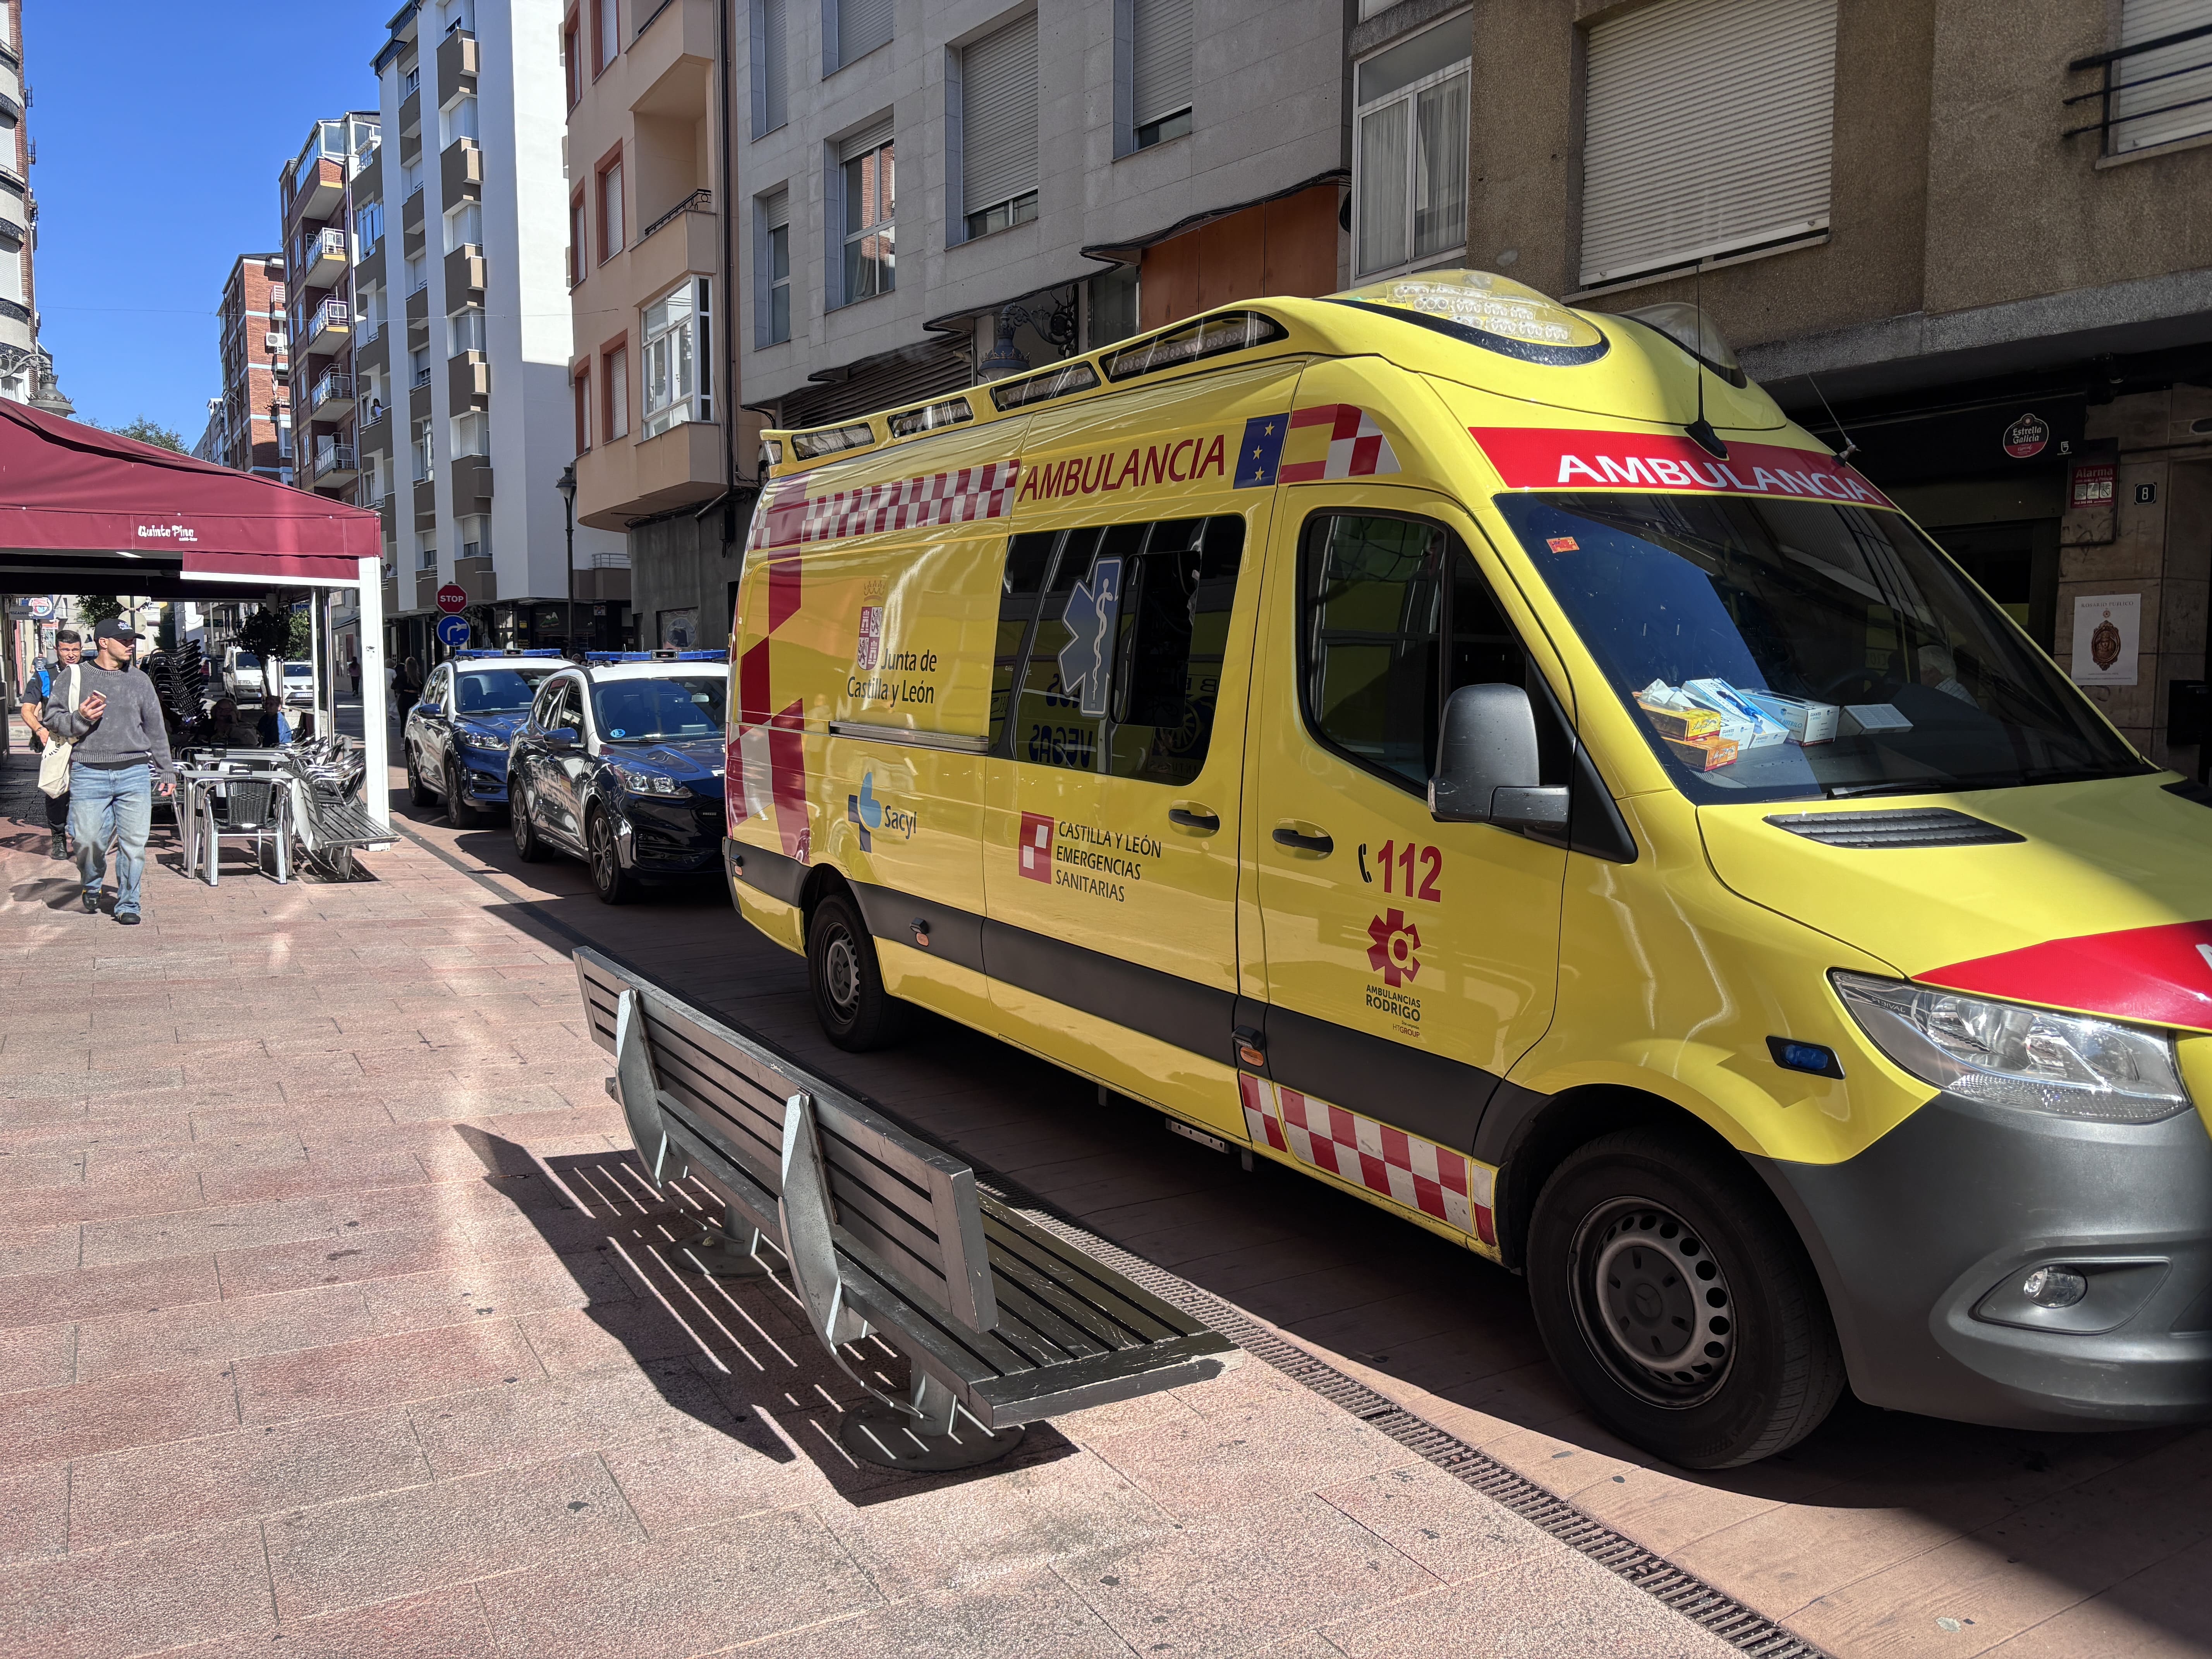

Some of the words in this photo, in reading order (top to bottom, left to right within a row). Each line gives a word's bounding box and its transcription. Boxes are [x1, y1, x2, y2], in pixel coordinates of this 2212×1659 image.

[2012, 426, 2042, 436] Estrella
[2013, 434, 2039, 444] Galicia
[1017, 434, 1225, 502] AMBULANCIA
[1557, 455, 1881, 504] AMBULANCIA
[2076, 468, 2113, 478] Alarma
[2142, 487, 2148, 500] 8
[138, 524, 171, 537] Quinto
[172, 525, 194, 537] Pino
[881, 649, 918, 673] Junta
[921, 649, 937, 673] de
[847, 676, 889, 701] Castilla
[890, 683, 900, 707] y
[902, 680, 935, 704] León
[1783, 719, 1803, 728] NITRILO
[884, 805, 917, 840] Sacyl
[1058, 821, 1111, 847] CASTILLA
[1115, 833, 1122, 849] Y
[1125, 835, 1161, 859] LEÓN
[1056, 845, 1141, 881] EMERGENCIAS
[1377, 840, 1443, 903] 112
[1056, 869, 1125, 902] SANITARIAS
[1366, 984, 1421, 1008] AMBULANCIAS
[1366, 994, 1421, 1022] RODRIGO
[1393, 1024, 1420, 1038] HTGROUP
